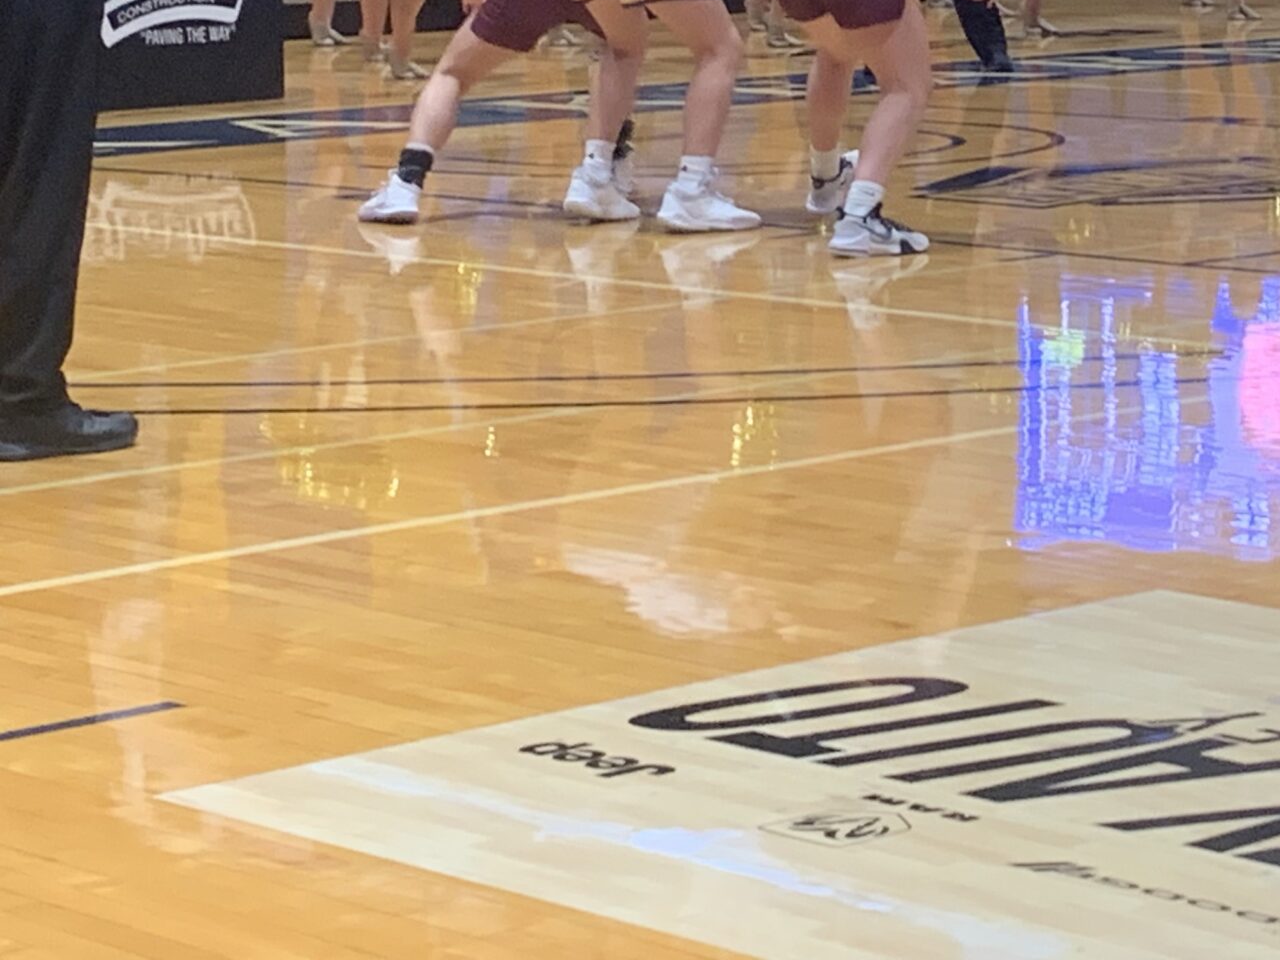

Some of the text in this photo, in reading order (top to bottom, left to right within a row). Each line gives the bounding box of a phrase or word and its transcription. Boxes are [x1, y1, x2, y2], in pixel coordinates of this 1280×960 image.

[186, 26, 206, 43] THE
[518, 740, 677, 778] Jeep
[862, 793, 979, 823] RAM
